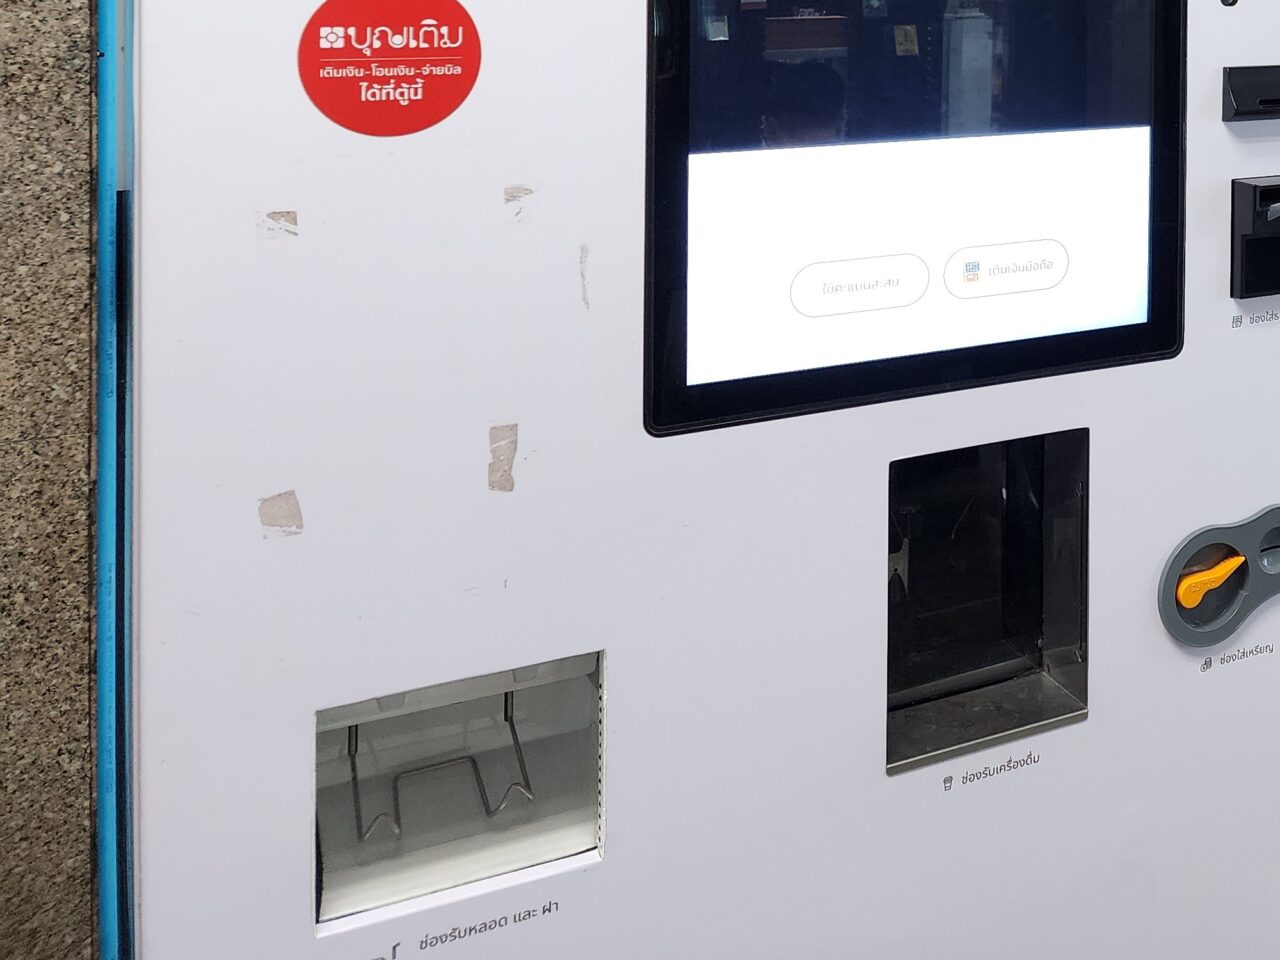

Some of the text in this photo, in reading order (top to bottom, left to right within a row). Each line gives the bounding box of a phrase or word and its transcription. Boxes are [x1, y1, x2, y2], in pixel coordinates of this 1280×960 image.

[347, 18, 463, 56] บุญเติม
[359, 78, 424, 105] ได้ที่ตู้นี้
[1220, 644, 1274, 665] ช่องใส่เหรียญ
[961, 750, 1040, 784] ช่องรับเครื่องดื่ม
[419, 901, 559, 950] ช่องรับหลอด และ ฝา
